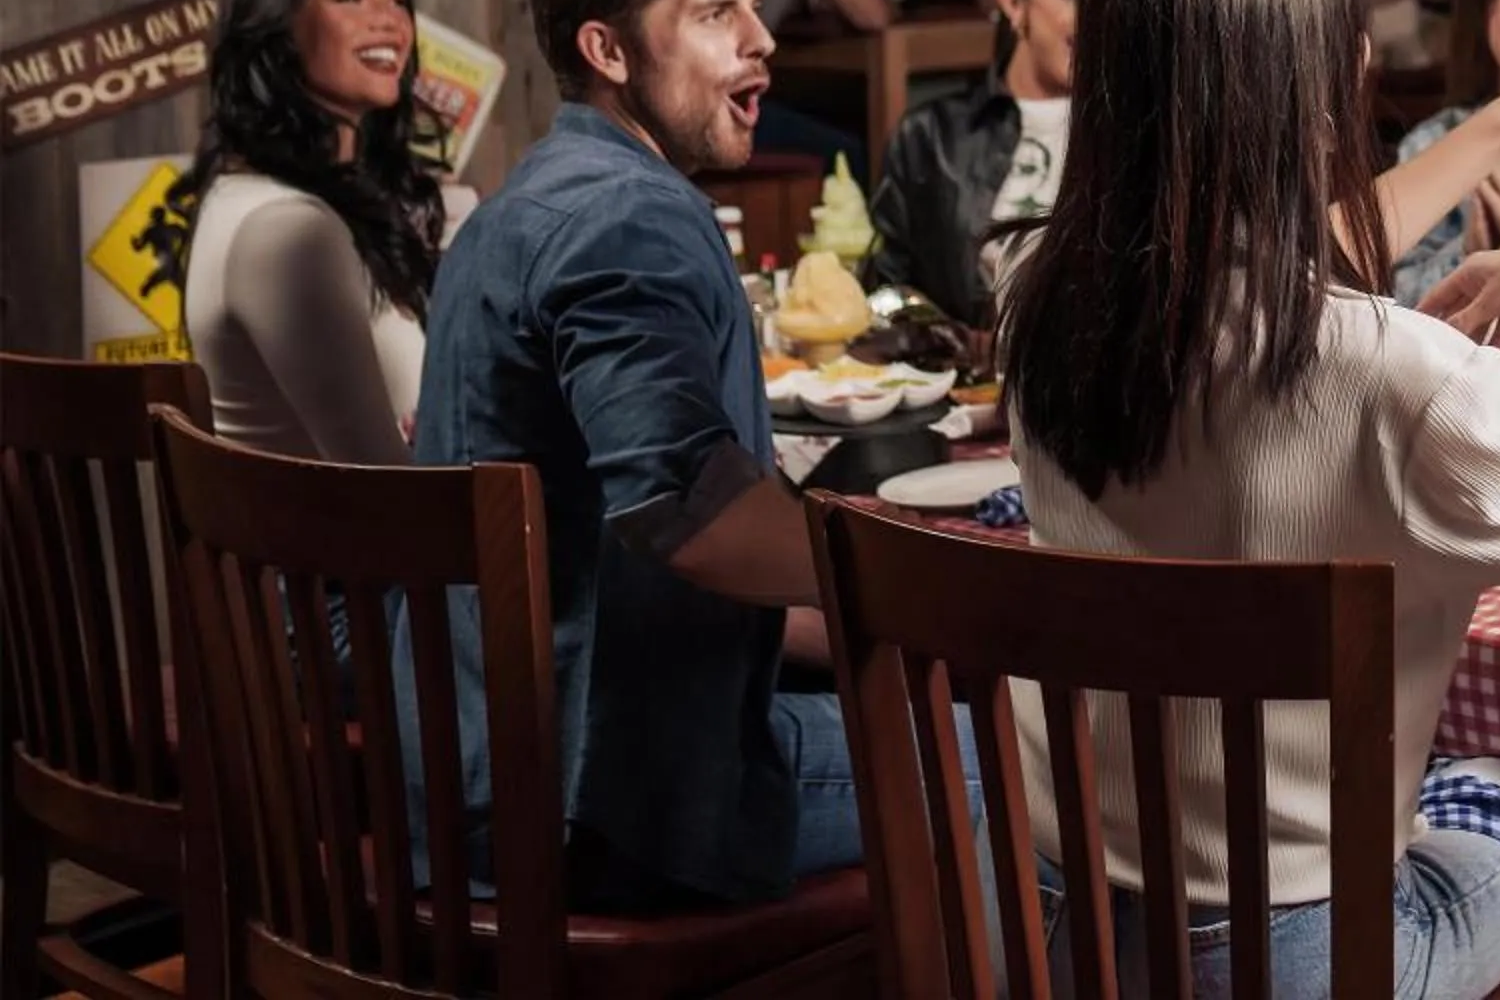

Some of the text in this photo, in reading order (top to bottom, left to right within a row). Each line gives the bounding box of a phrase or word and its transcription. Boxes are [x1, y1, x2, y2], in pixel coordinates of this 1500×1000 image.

[57, 40, 85, 75] IT
[94, 23, 144, 63] ALL
[145, 8, 182, 46] ON
[7, 40, 207, 135] BOOTS
